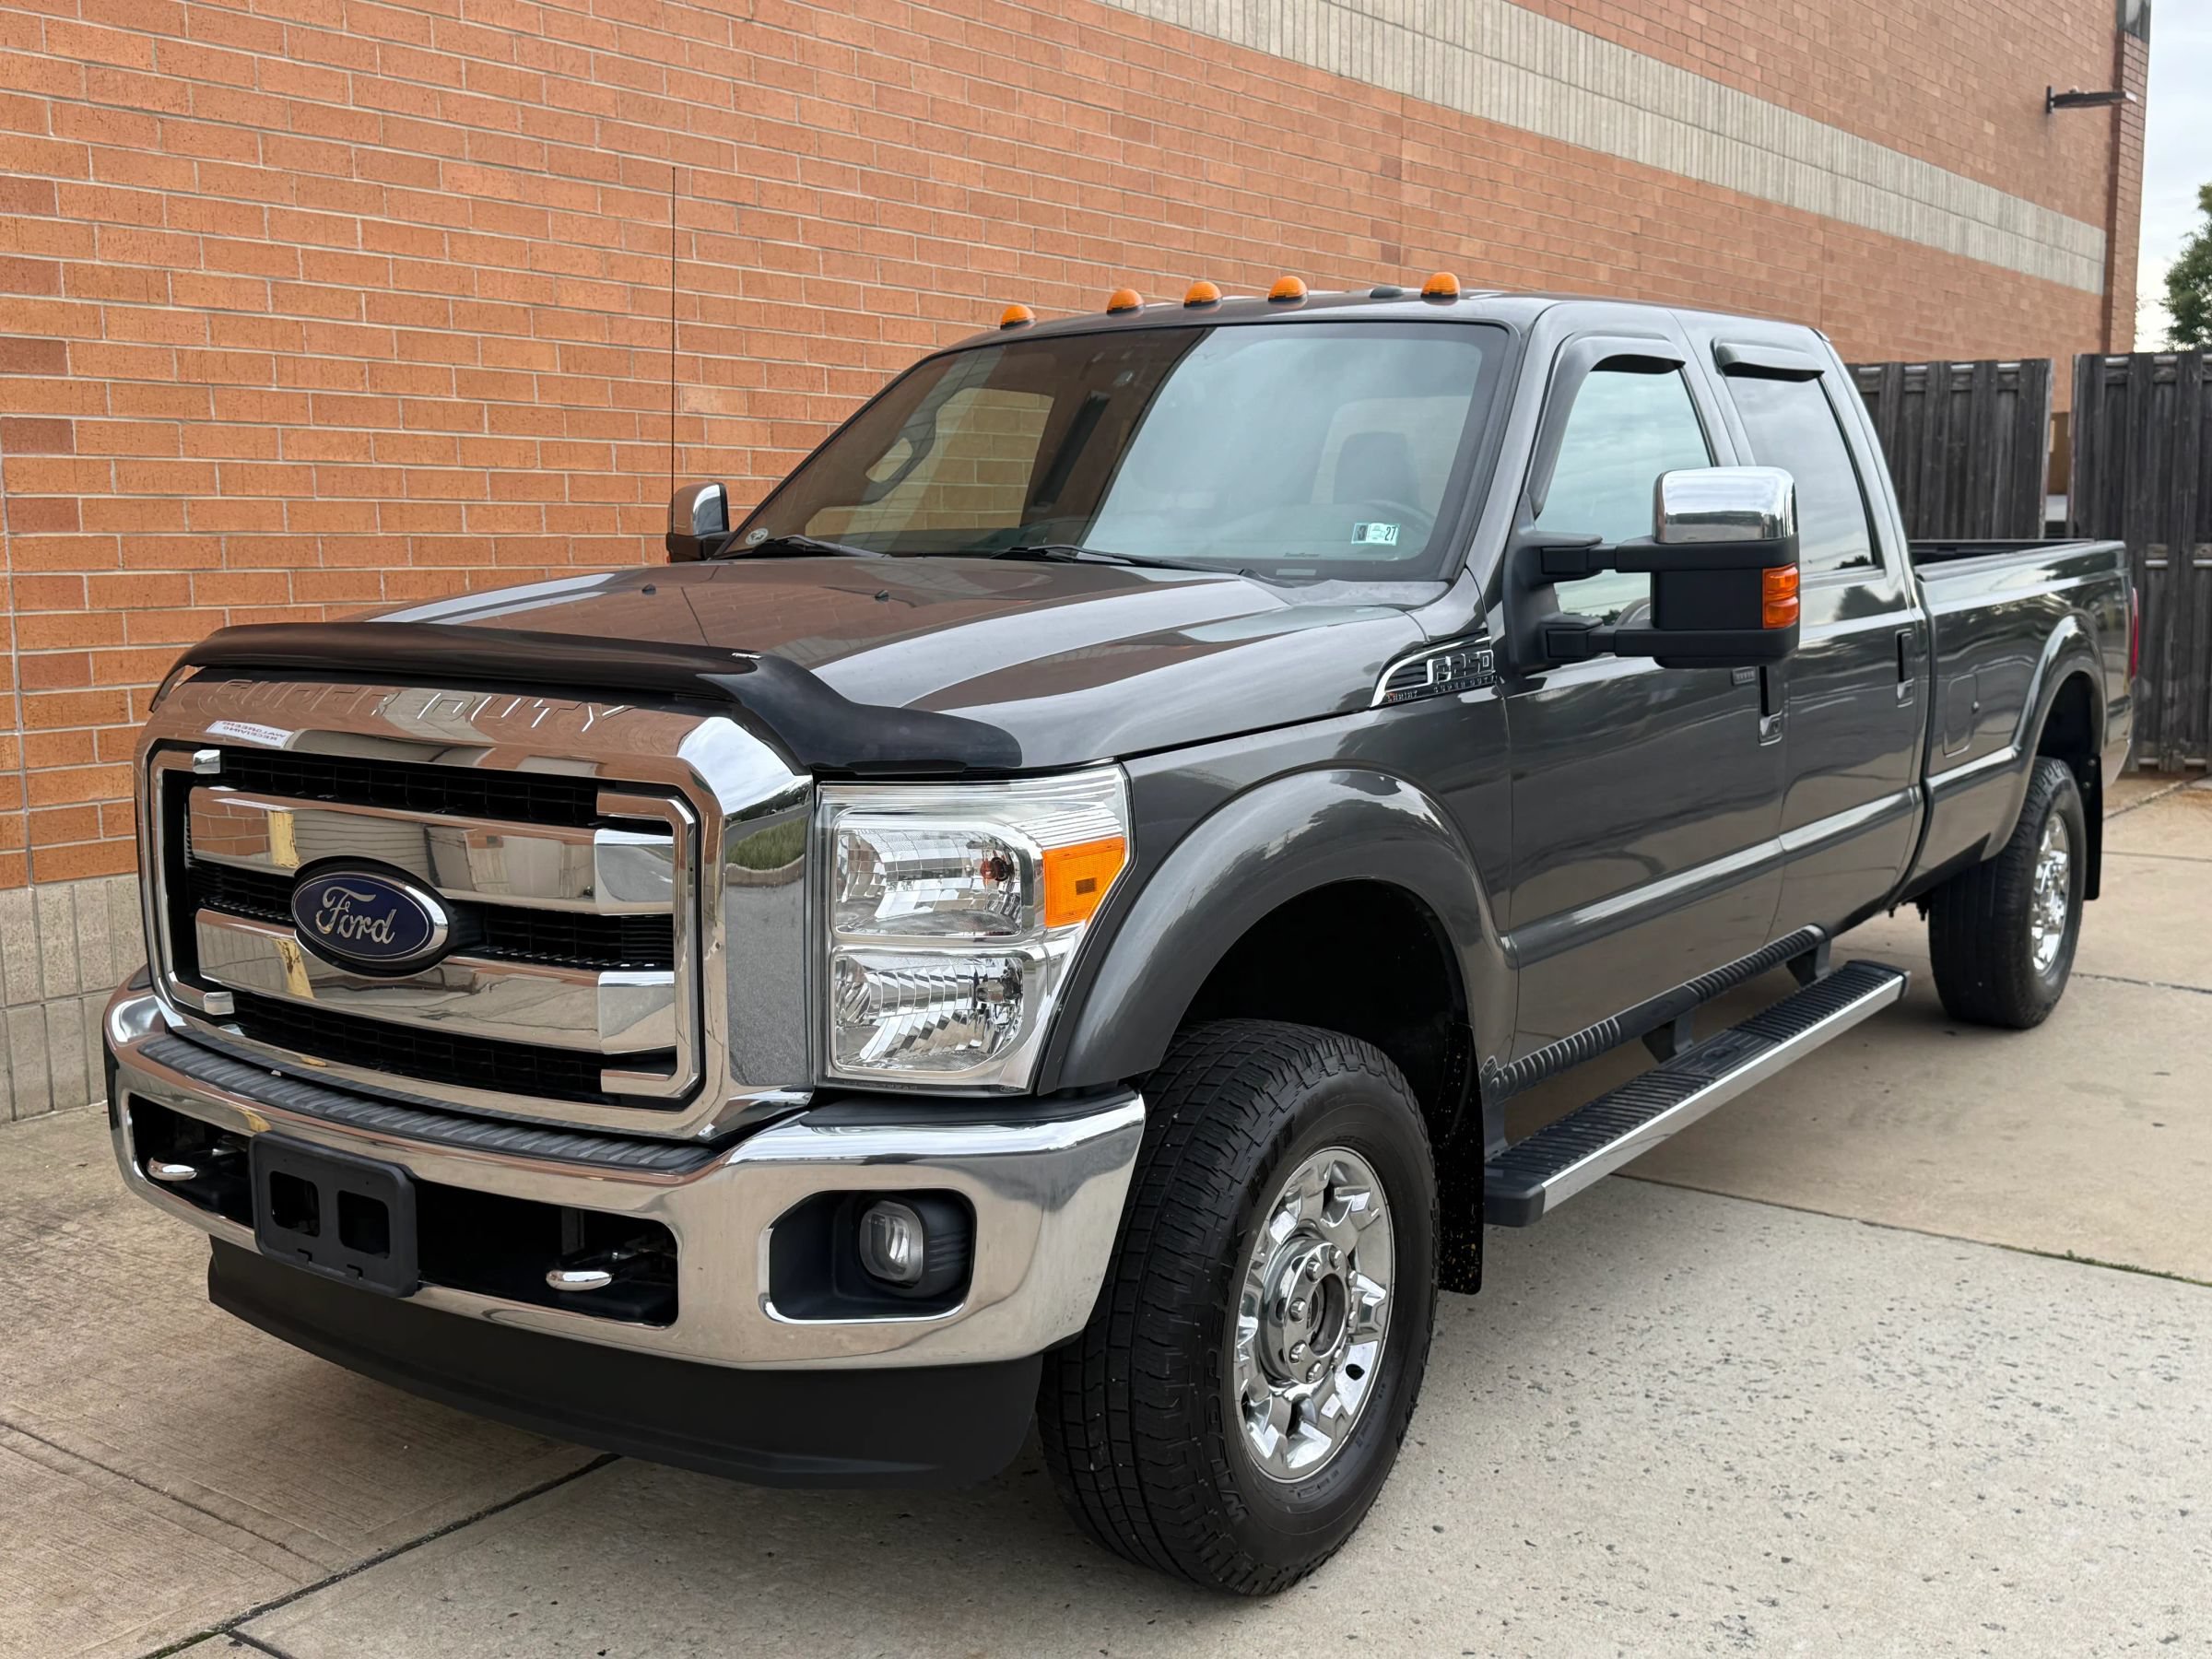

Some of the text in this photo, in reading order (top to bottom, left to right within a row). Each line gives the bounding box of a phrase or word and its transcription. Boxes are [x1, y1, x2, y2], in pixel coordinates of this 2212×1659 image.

[1384, 526, 1396, 541] 27
[207, 679, 638, 733] SUPER DUTY
[315, 886, 398, 945] Ford
